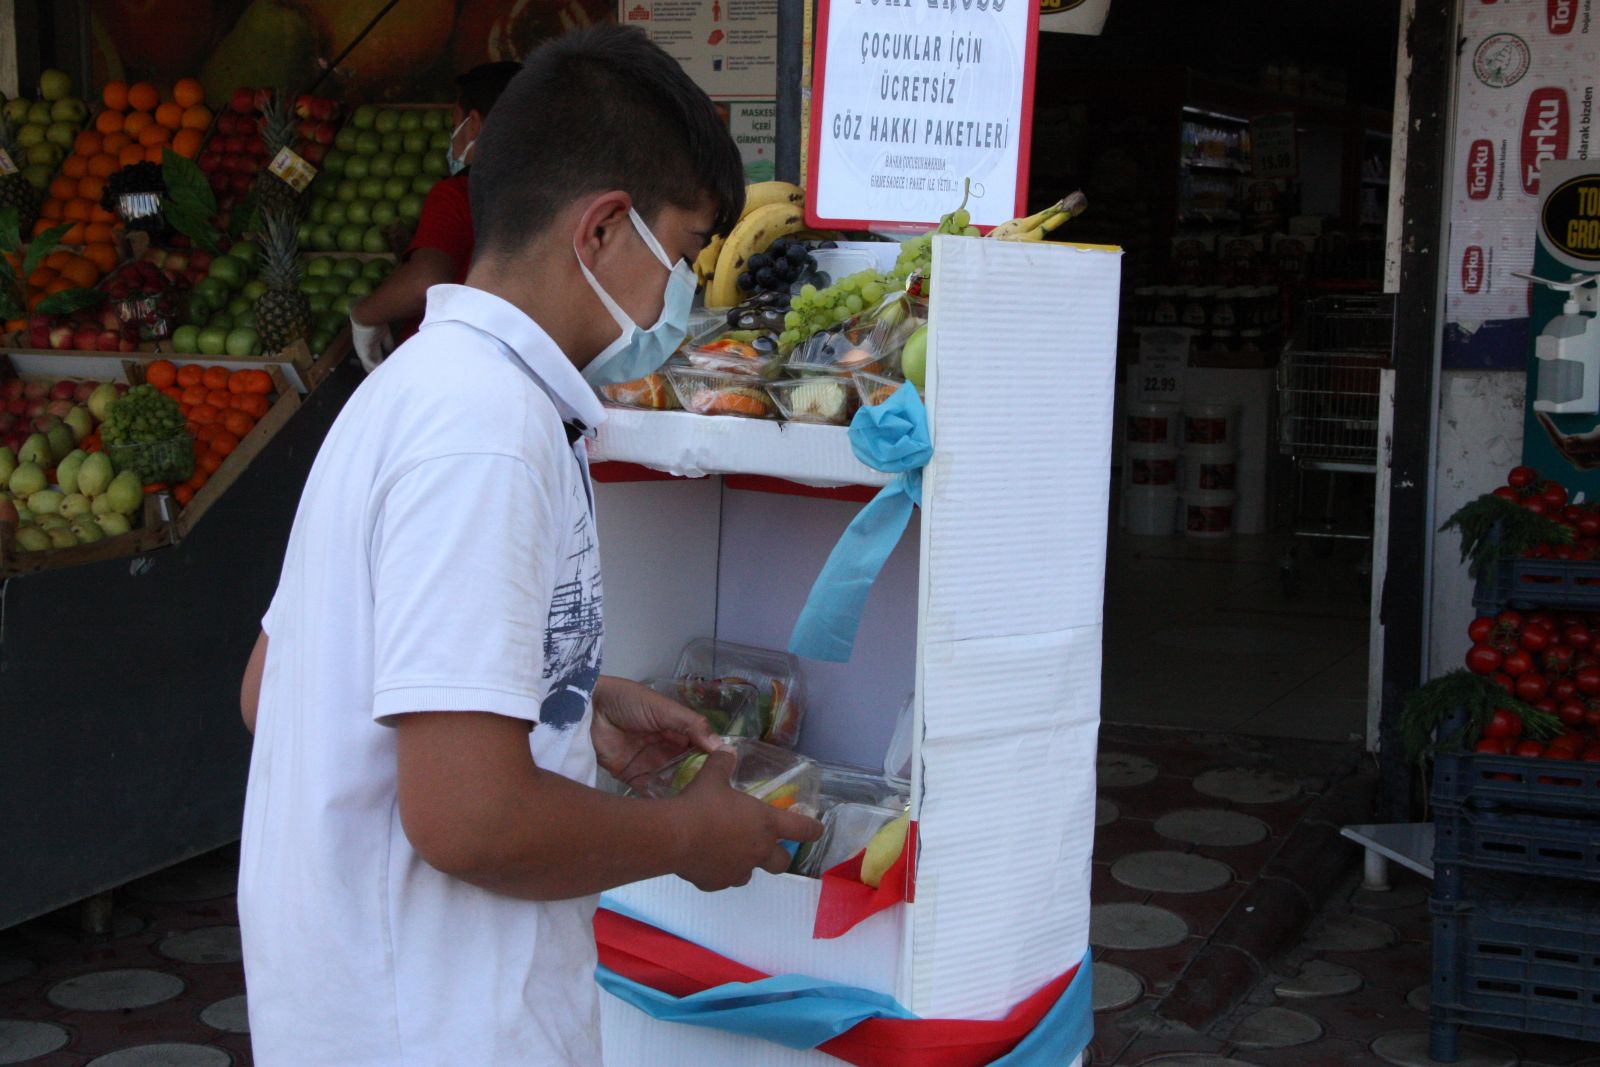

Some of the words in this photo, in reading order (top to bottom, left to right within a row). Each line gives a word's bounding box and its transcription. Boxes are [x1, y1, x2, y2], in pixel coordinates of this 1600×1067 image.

[861, 32, 942, 64] ÇOCUKLAR
[949, 30, 982, 69] İÇİN
[880, 69, 956, 104] ÜCRETSİZ
[1580, 87, 1593, 124] bizden
[833, 109, 862, 141] GÖZ
[870, 116, 917, 144] HAKKI
[925, 118, 1009, 149] PAKETLERİ
[1578, 126, 1590, 160] olarak
[1470, 146, 1489, 196] Torku
[1578, 187, 1600, 216] TO
[1567, 219, 1600, 249] GRO
[1464, 250, 1480, 291] Torku
